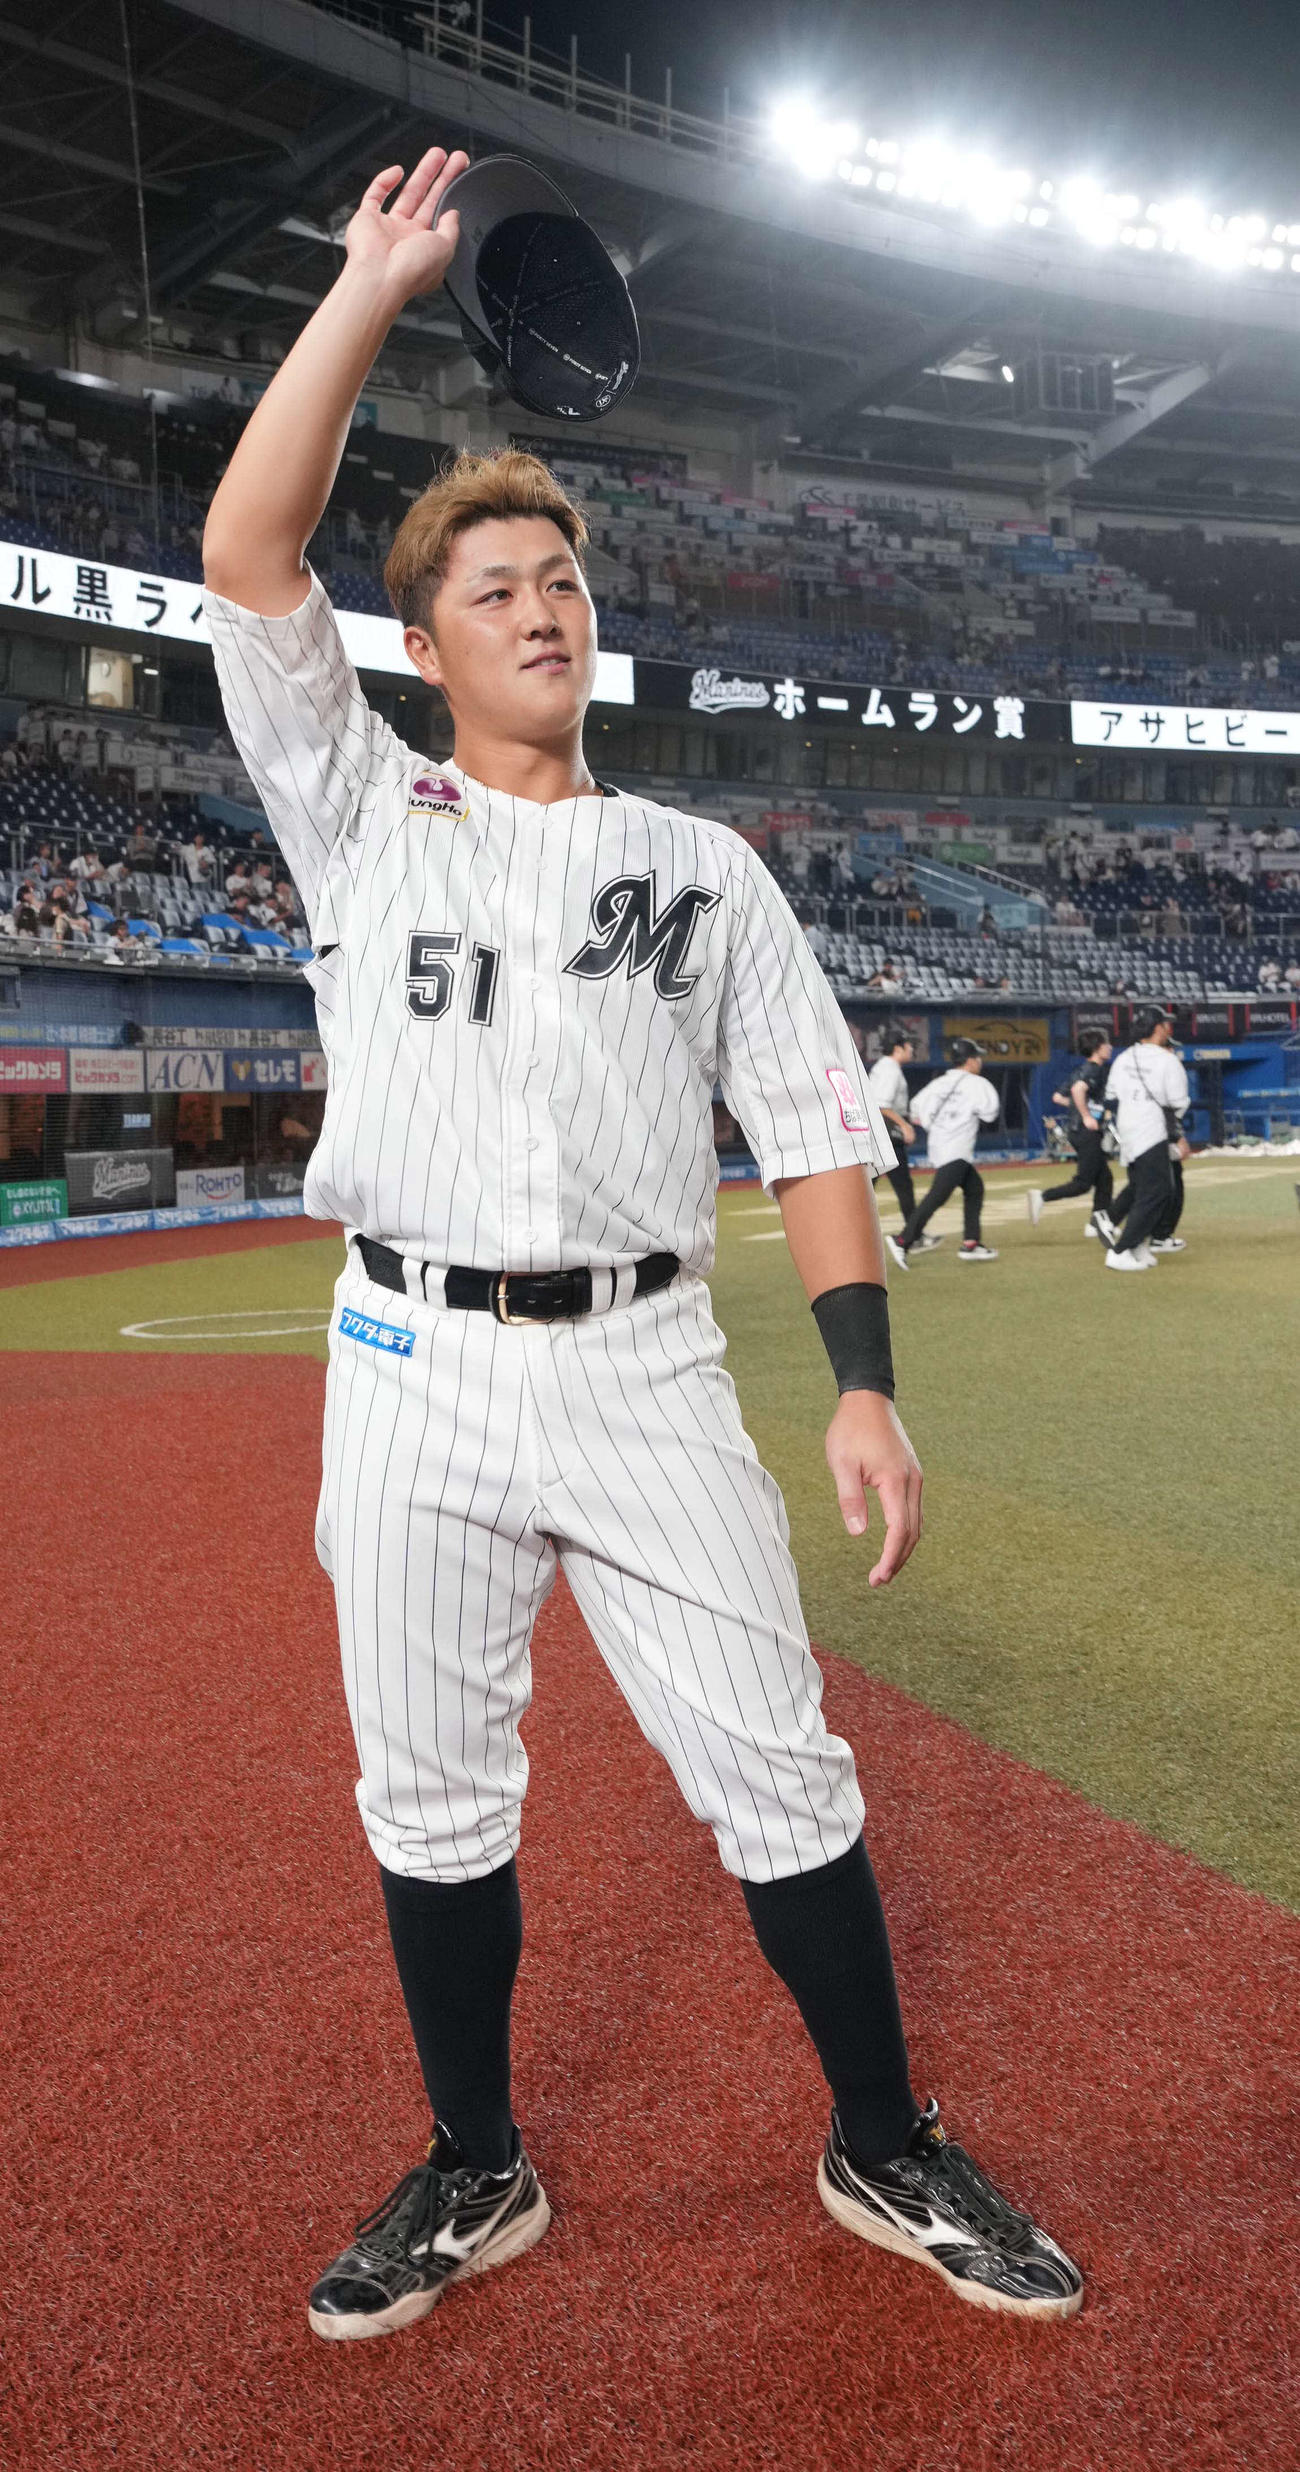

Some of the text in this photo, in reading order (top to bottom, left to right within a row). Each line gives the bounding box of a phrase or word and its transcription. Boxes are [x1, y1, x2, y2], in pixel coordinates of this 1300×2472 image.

[11, 555, 203, 628] ル黒ラ
[690, 669, 770, 714] Marines
[773, 678, 1025, 740] ホームラン賞
[1100, 711, 1287, 747] アサヒビー
[561, 869, 723, 1000] M
[405, 930, 501, 1027] 51
[151, 1053, 221, 1090] ACN
[254, 1060, 297, 1084] セレモ
[195, 1173, 242, 1196] ROHTO
[343, 1311, 412, 1351] フクダ電子
